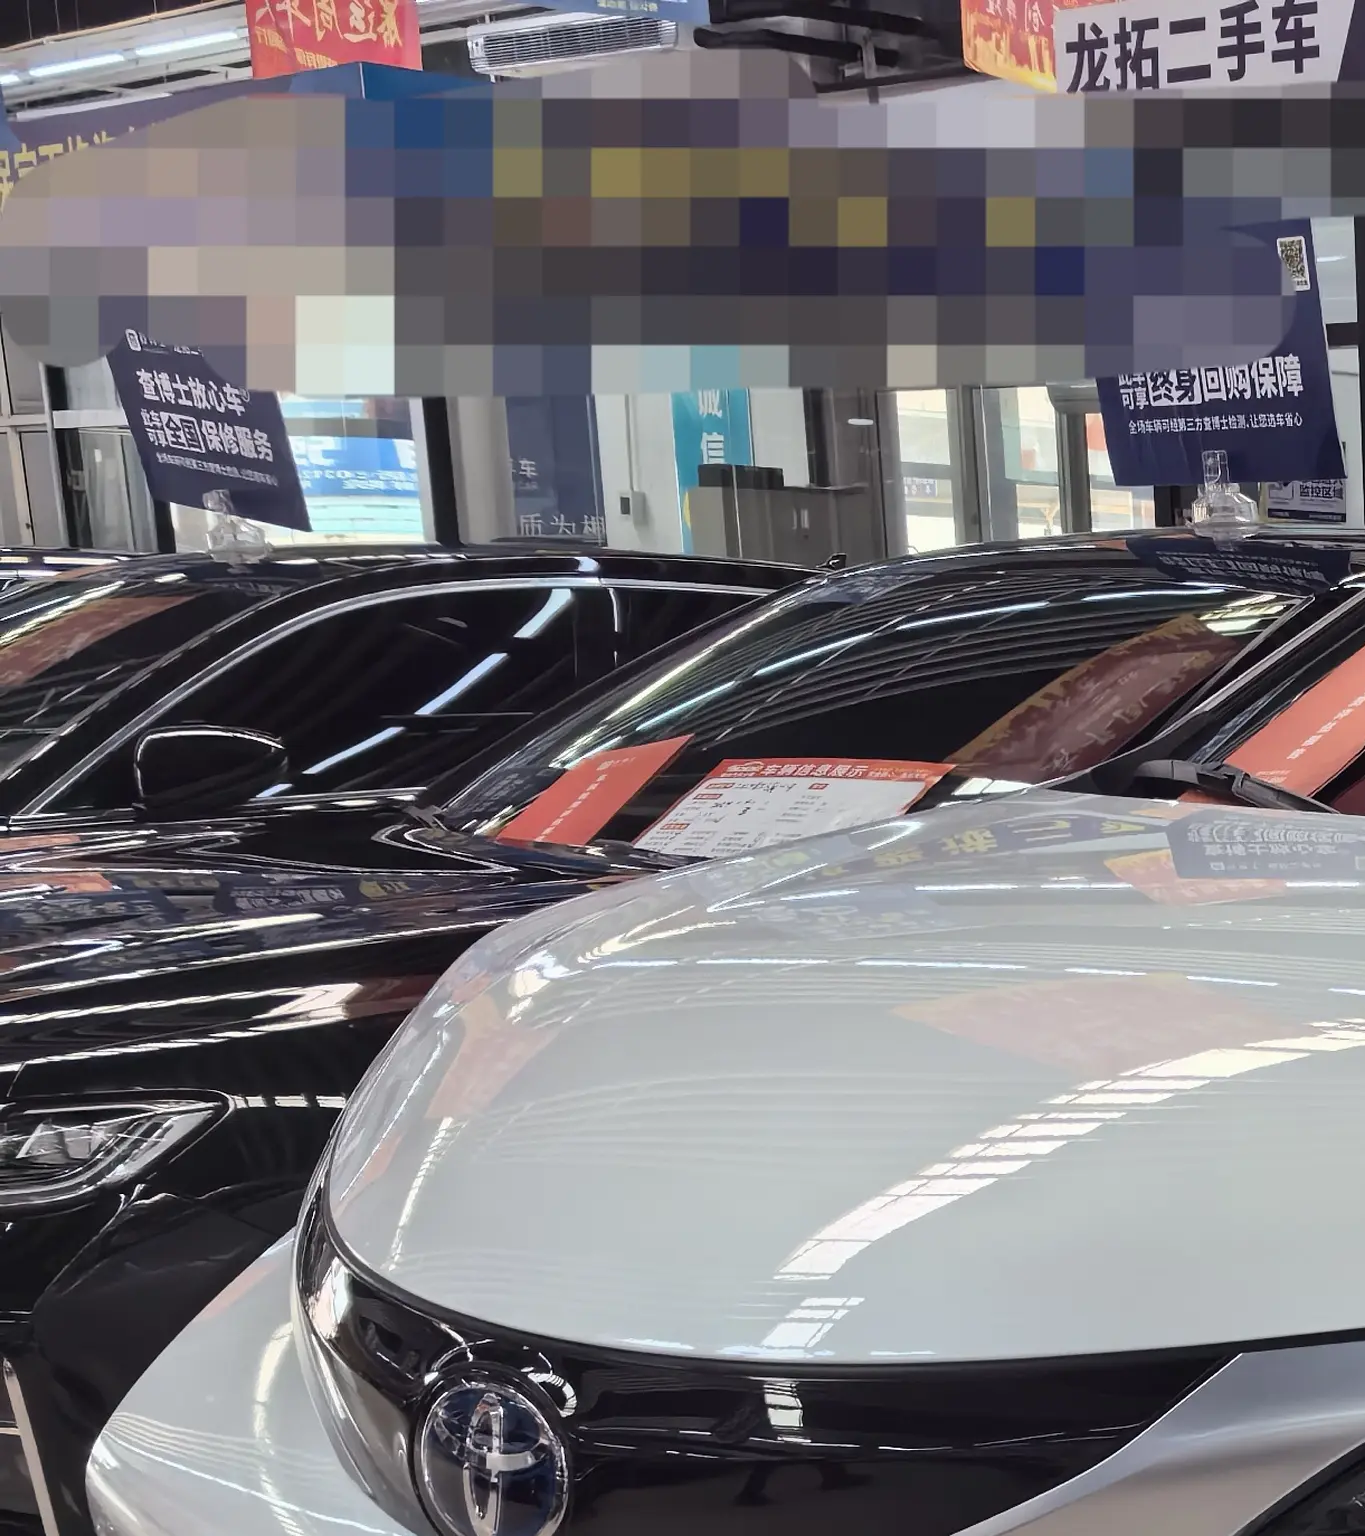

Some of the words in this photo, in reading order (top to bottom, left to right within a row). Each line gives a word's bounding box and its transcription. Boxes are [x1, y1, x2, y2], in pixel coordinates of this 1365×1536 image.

[1065, 0, 1320, 94] 龙拓二手车
[136, 368, 247, 416] 查博士放心车
[1150, 353, 1304, 407] 终身回购保障
[763, 764, 869, 778] 车辆信息展示
